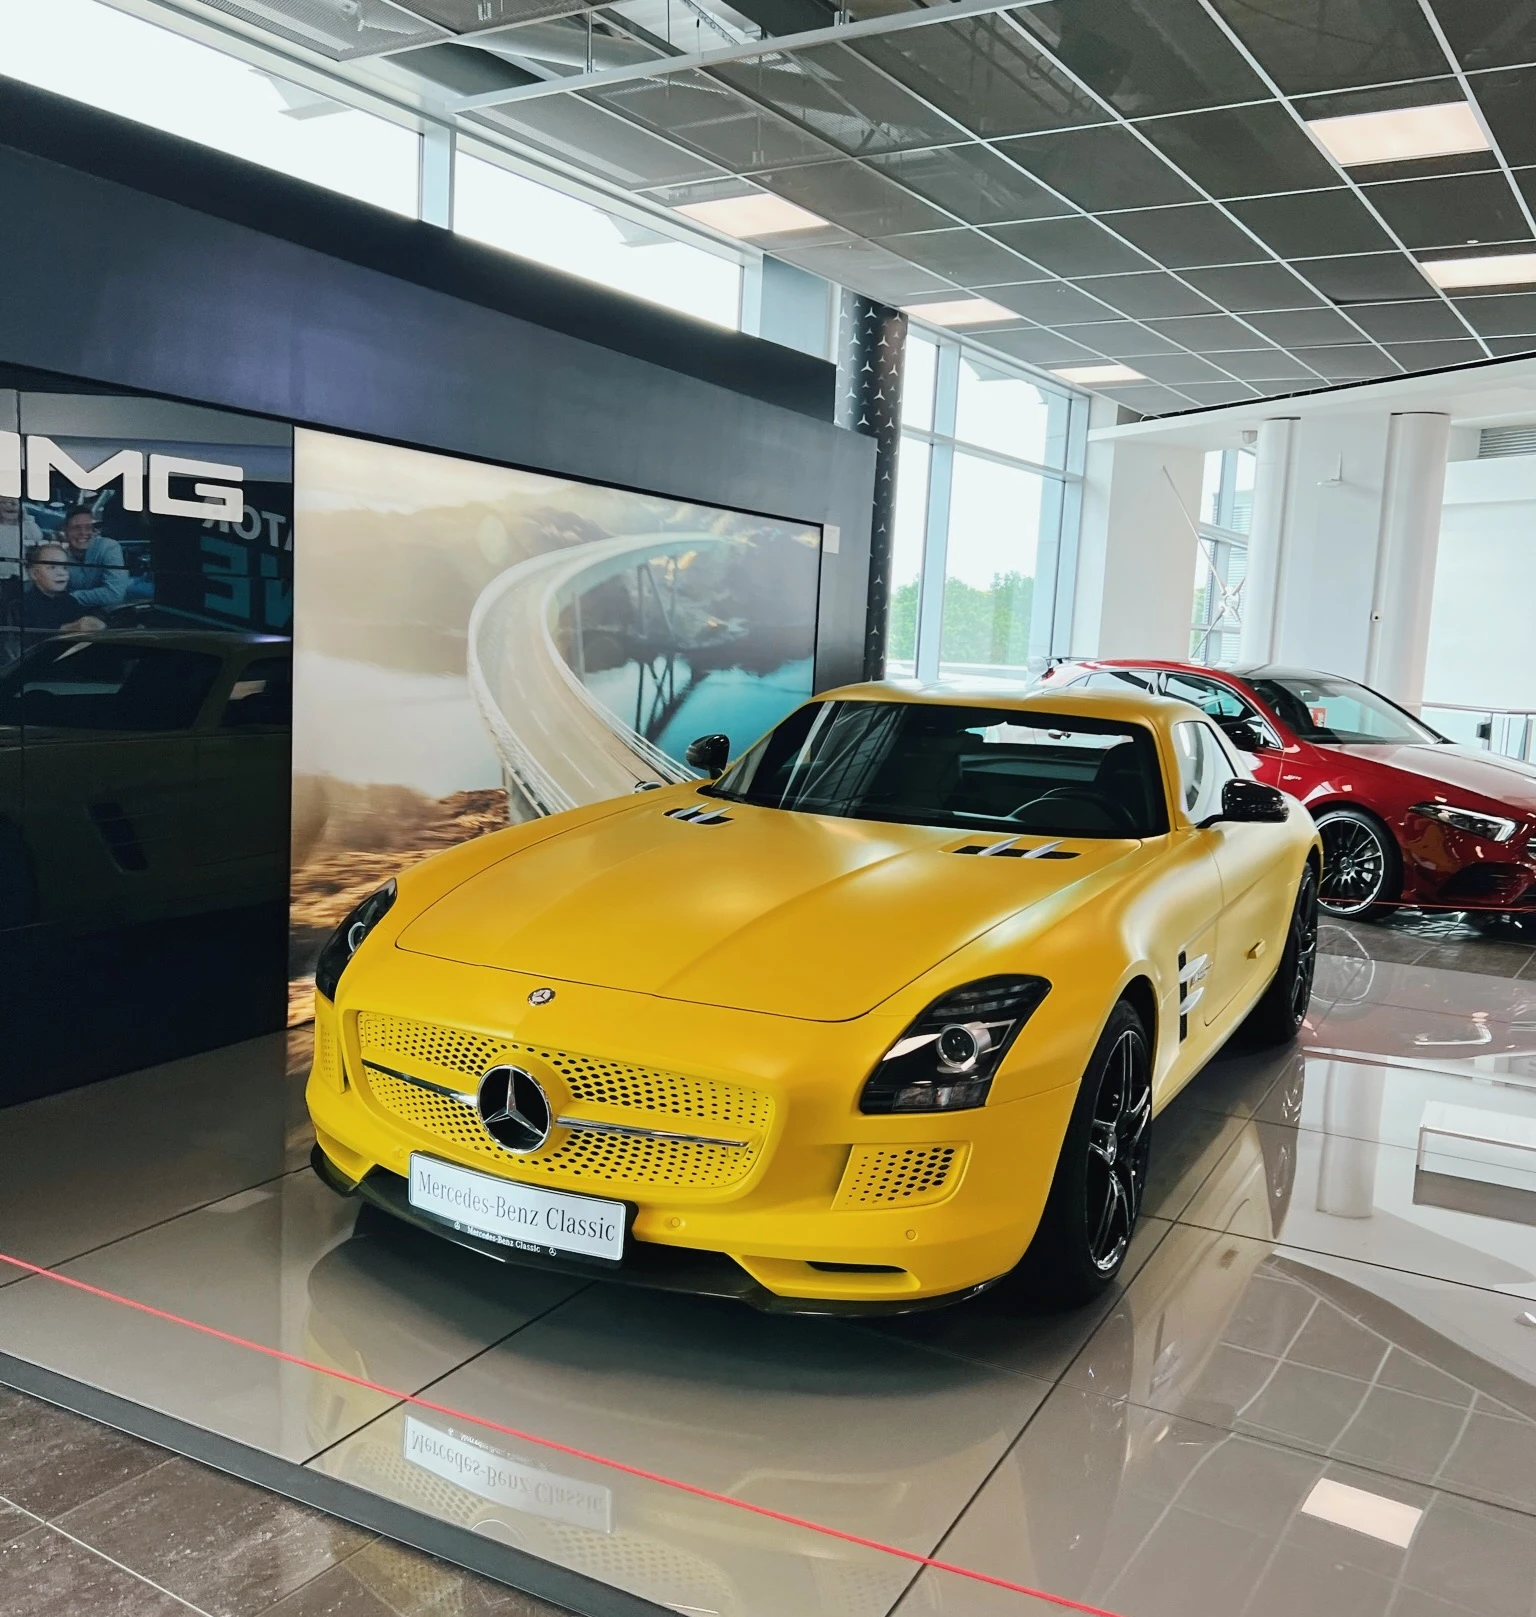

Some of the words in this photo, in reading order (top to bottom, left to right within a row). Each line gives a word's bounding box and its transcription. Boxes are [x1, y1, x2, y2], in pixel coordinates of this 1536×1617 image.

[0, 430, 243, 522] MG
[418, 1171, 539, 1226] Mercedes-Benz
[546, 1207, 615, 1242] Classic
[467, 1226, 514, 1247] Mercedes-Benz
[515, 1240, 541, 1253] Classic
